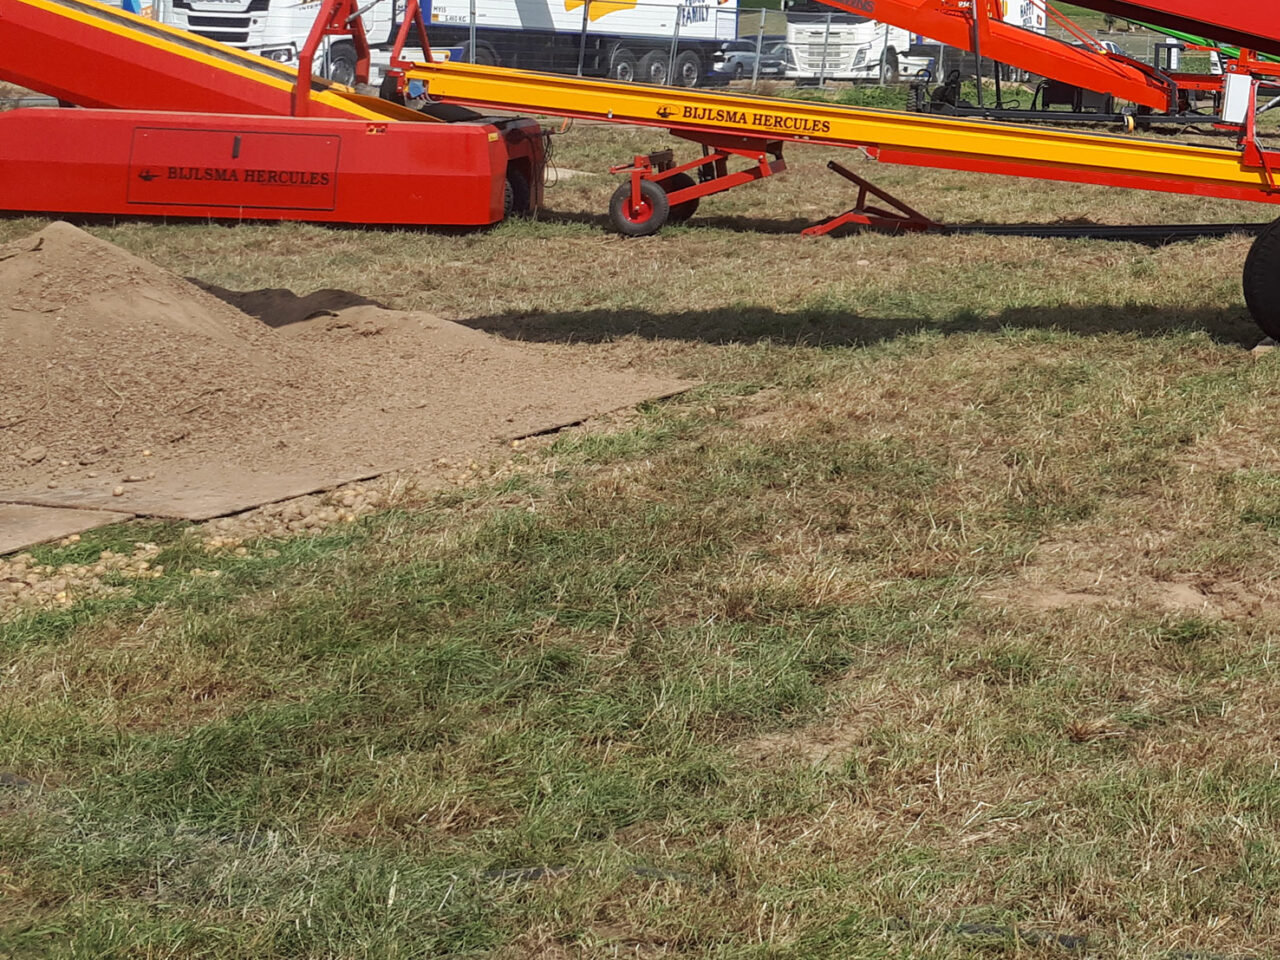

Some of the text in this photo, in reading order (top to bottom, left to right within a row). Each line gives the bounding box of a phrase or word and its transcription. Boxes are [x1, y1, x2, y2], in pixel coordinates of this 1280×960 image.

[681, 4, 710, 25] FAMILY
[683, 106, 748, 125] BIJLSMA
[752, 113, 831, 133] HERCULES
[167, 167, 330, 186] BIJLSMA HERCULES
